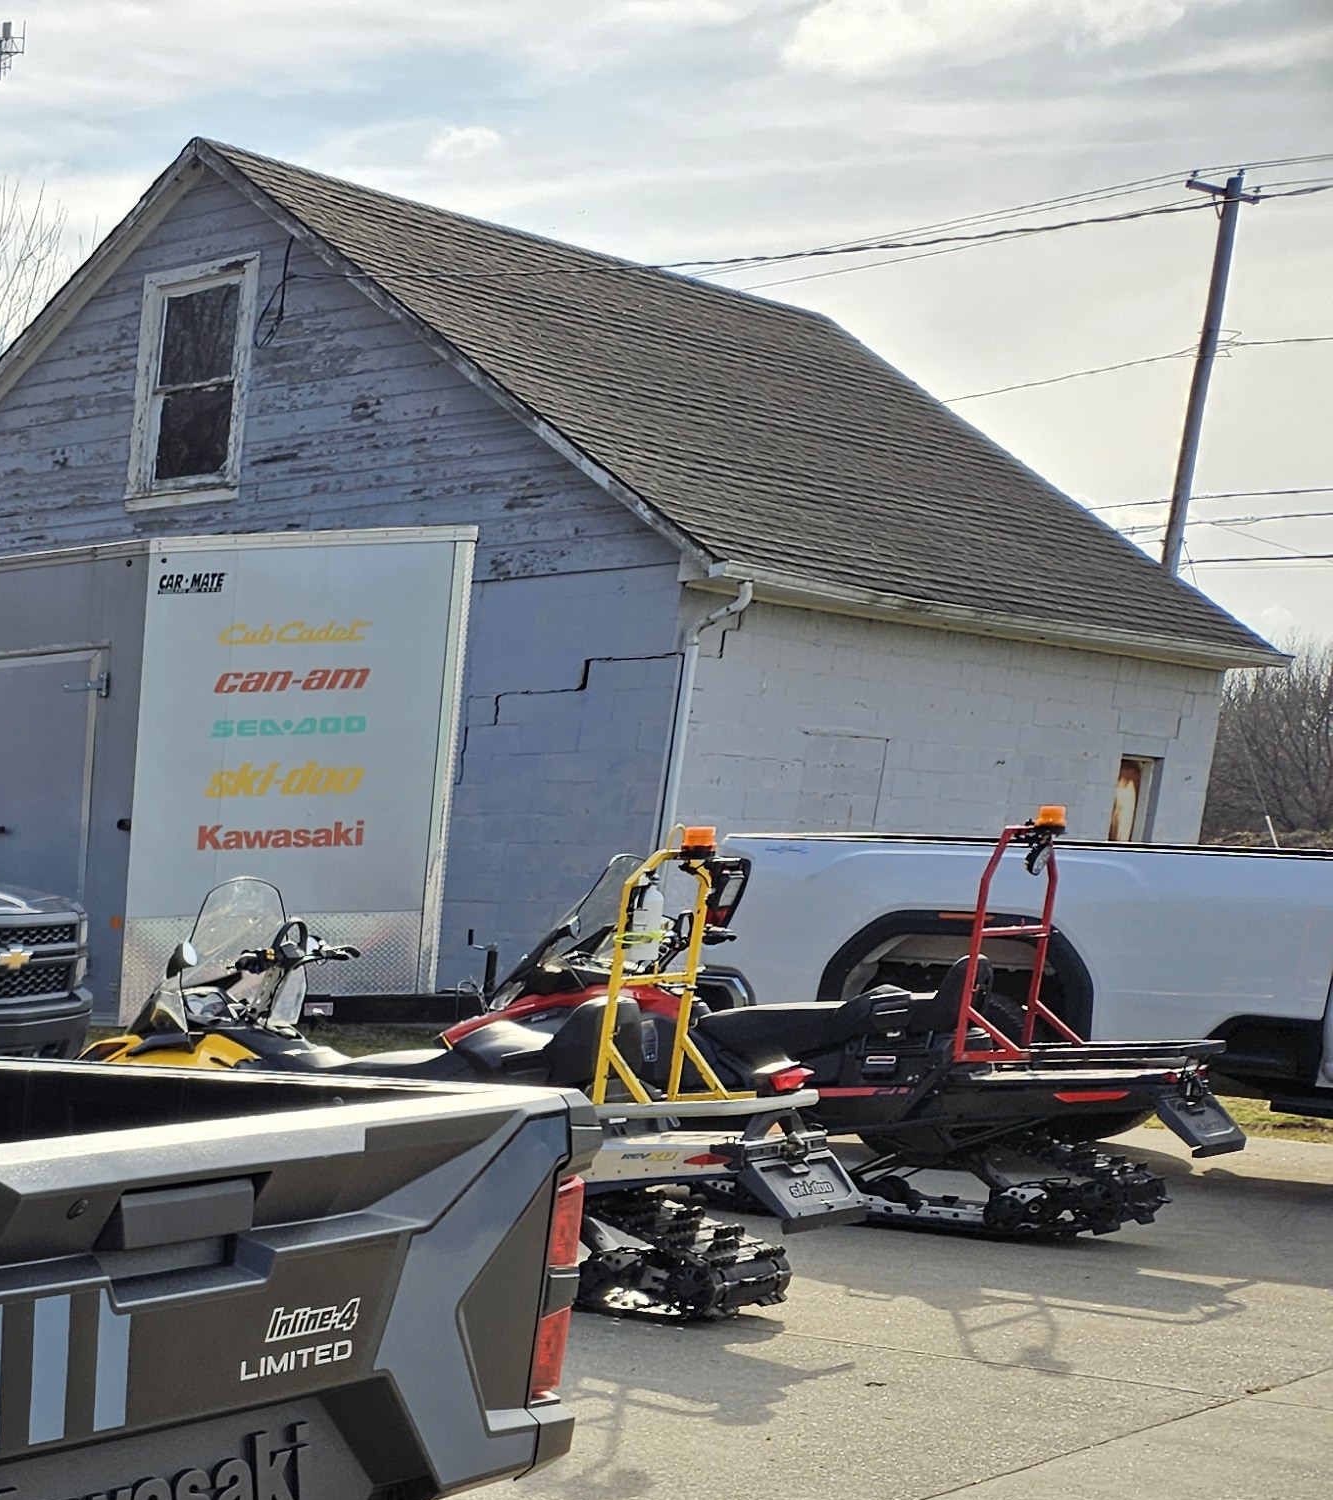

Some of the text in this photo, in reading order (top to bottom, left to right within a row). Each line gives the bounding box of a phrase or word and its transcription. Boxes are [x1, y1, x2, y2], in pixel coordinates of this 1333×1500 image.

[218, 619, 373, 646] Cub Cadet
[214, 668, 372, 693] can-am
[204, 760, 365, 798] ski-doo
[197, 820, 365, 851] Kawasaki
[264, 1297, 361, 1343] Inline-4
[240, 1339, 353, 1381] LIMITED
